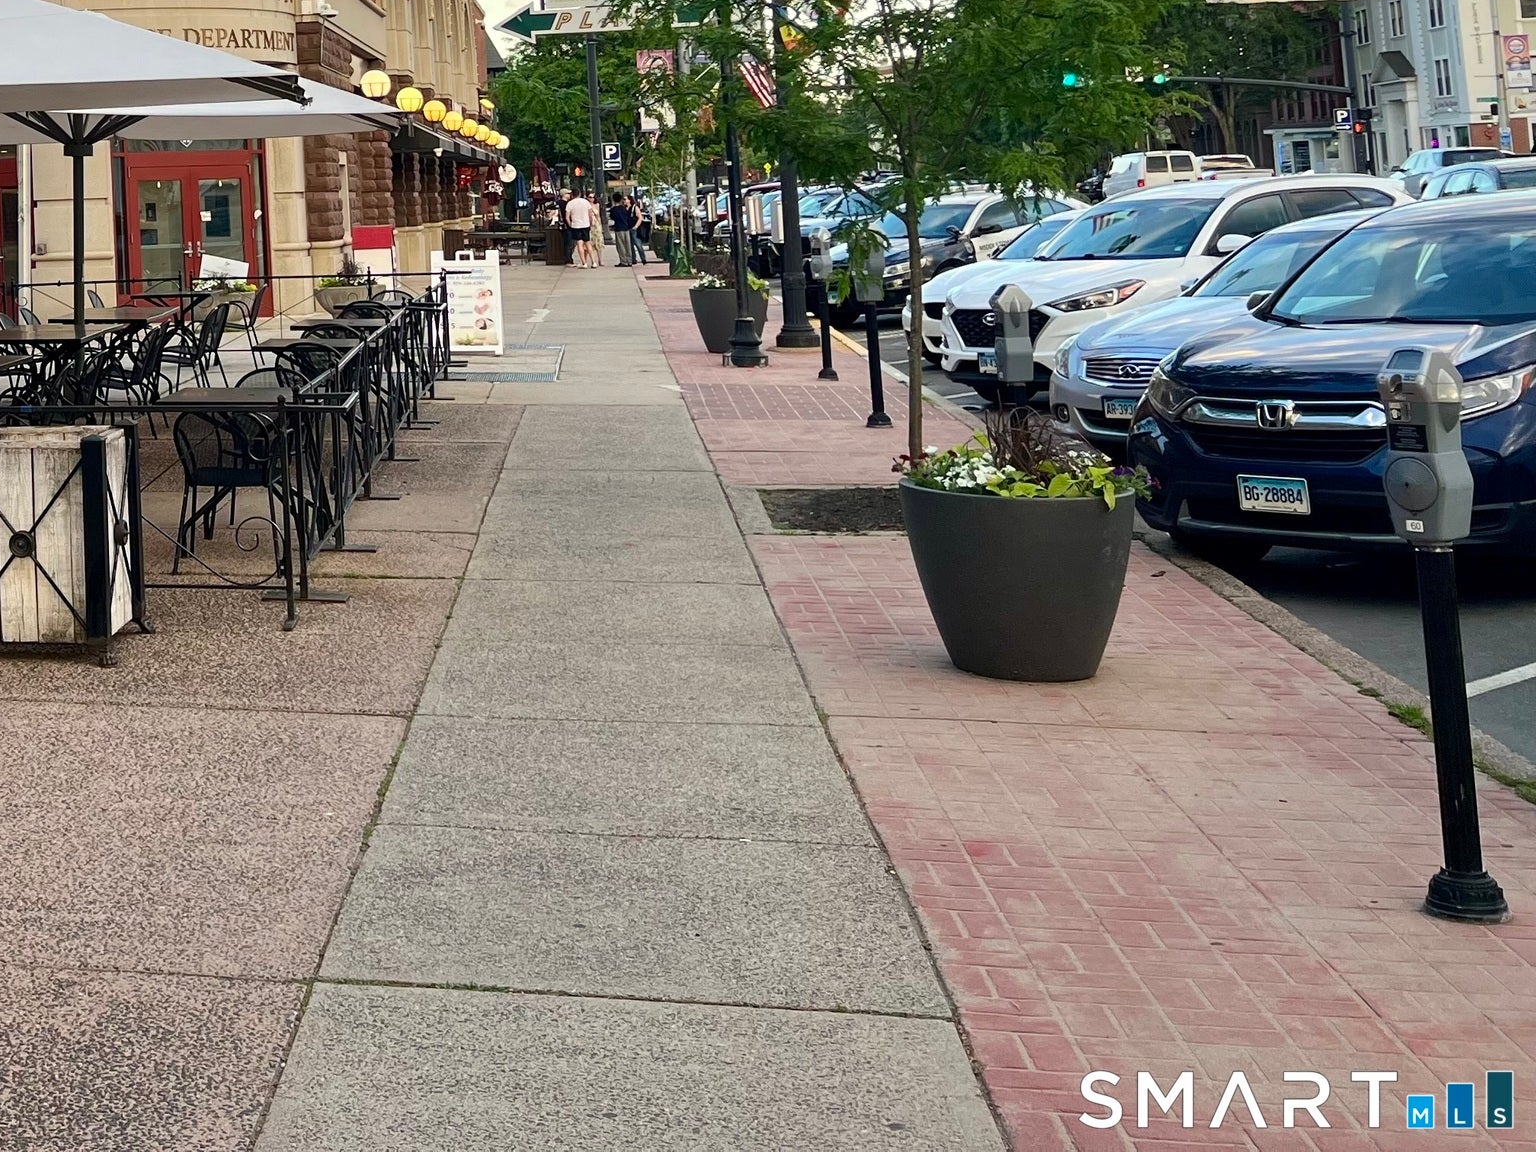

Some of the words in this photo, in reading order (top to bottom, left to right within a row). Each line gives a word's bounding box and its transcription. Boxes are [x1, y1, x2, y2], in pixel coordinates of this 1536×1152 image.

[182, 27, 295, 52] DEPARTMENT
[1336, 110, 1348, 123] P
[605, 145, 617, 159] P
